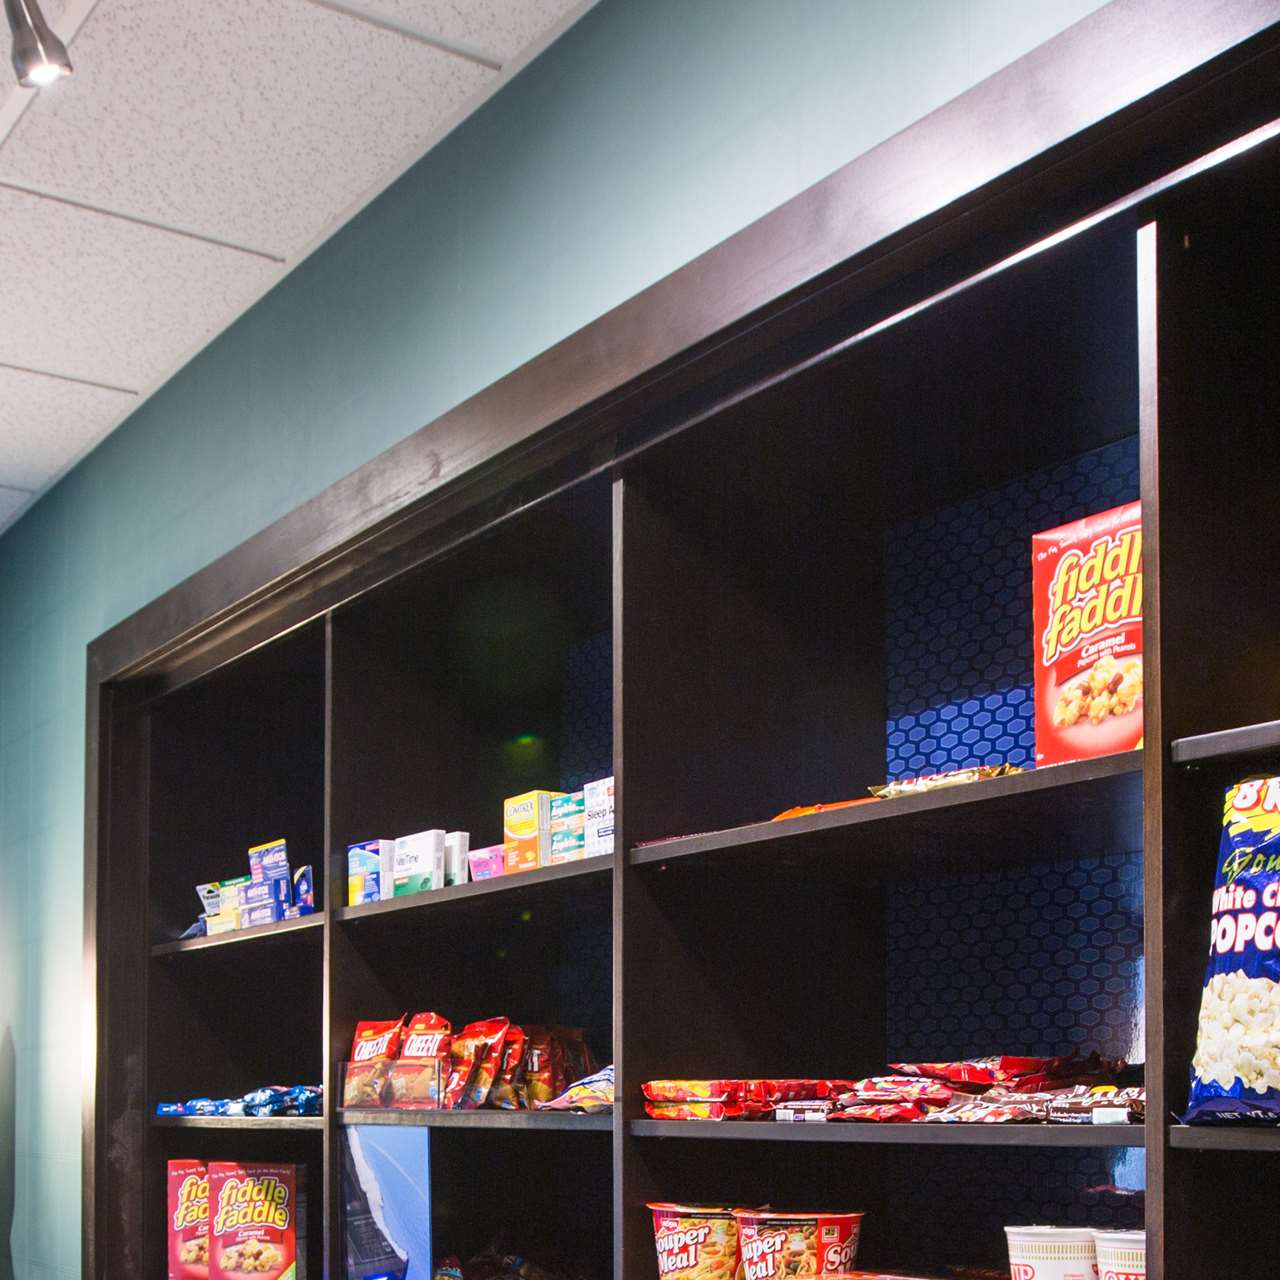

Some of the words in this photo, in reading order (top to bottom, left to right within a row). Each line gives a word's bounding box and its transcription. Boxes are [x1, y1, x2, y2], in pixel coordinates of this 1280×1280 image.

[1081, 632, 1125, 657] Caramel
[219, 1177, 288, 1207] fiddle
[215, 1200, 289, 1234] faddle
[657, 1226, 710, 1252] ouper
